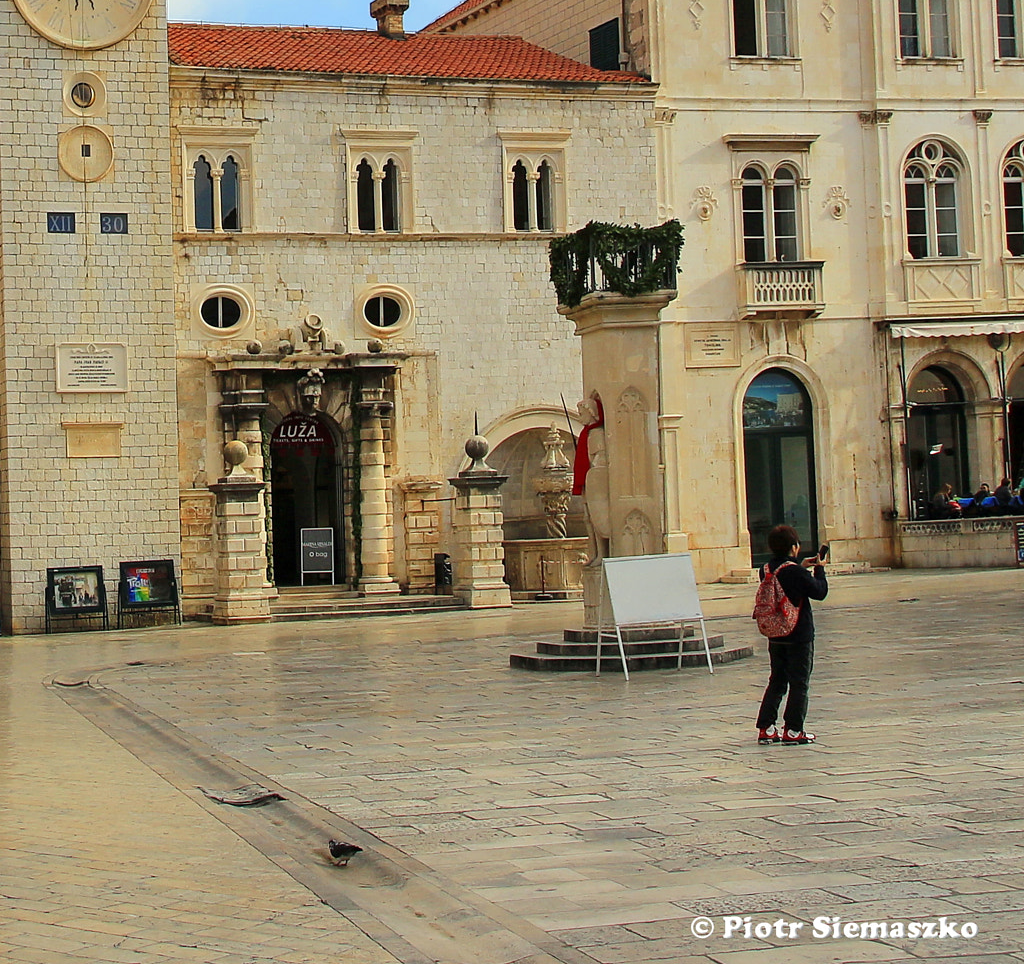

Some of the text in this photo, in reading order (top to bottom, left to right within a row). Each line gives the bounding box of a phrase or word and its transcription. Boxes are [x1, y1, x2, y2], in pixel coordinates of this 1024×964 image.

[49, 216, 72, 232] XII
[102, 217, 124, 233] 30
[279, 422, 317, 437] LUŽA
